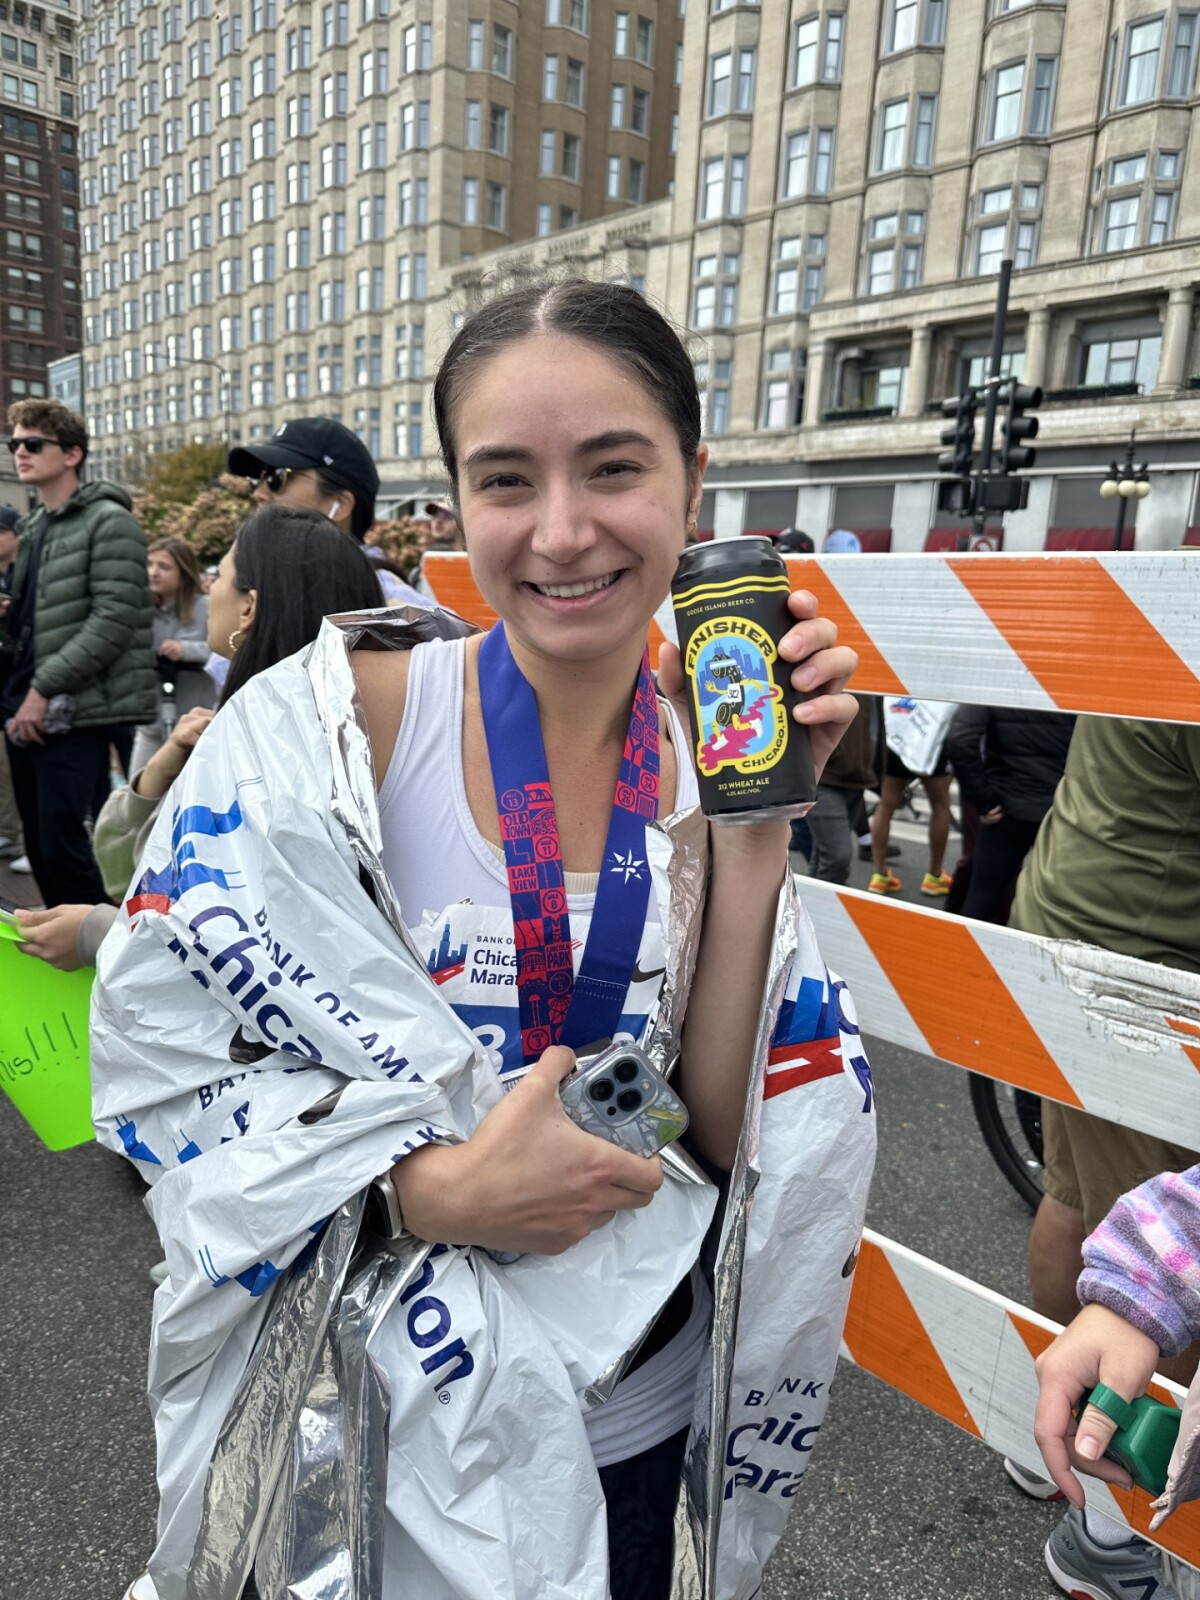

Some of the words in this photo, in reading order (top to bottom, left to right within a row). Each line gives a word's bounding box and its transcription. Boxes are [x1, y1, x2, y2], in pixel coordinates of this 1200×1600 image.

[686, 606, 703, 617] GOOSE
[704, 602, 727, 612] ISLAND
[727, 598, 744, 607] BEER
[744, 597, 756, 605] CO.
[687, 620, 773, 669] FINISHER
[777, 710, 784, 723] IL
[718, 783, 728, 791] 312
[728, 779, 755, 788] WHEAT
[755, 777, 770, 786] ALE
[508, 798, 519, 807] 13
[503, 812, 529, 827] OLD
[504, 823, 532, 839] TOWN
[542, 846, 552, 856] 11
[511, 865, 537, 879] LAKE
[551, 899, 558, 910] 8
[476, 935, 503, 945] BANK
[505, 937, 516, 945] O
[547, 951, 571, 969] PARK
[254, 905, 316, 989] BANK
[358, 1032, 426, 1083] AM
[535, 1038, 542, 1049] 3
[743, 1377, 825, 1406] BNK
